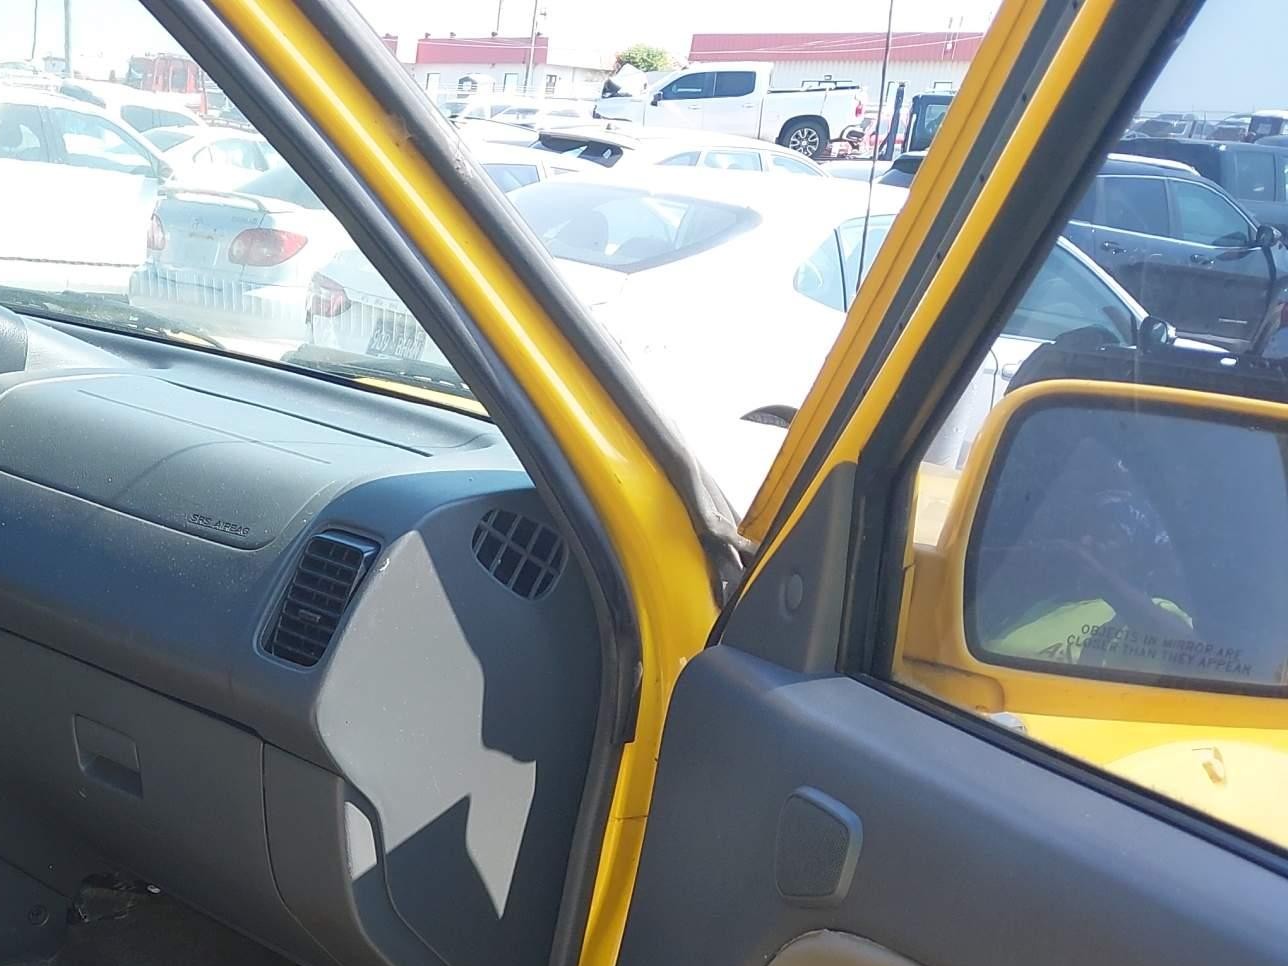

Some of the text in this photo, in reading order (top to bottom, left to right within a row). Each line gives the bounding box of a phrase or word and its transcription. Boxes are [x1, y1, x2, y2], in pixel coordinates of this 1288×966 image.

[190, 513, 212, 525] SRS
[1067, 634, 1253, 676] CLOSER THAN THEY APPEAR
[1081, 624, 1242, 660] OBJECTS IN MIRROR ARE
